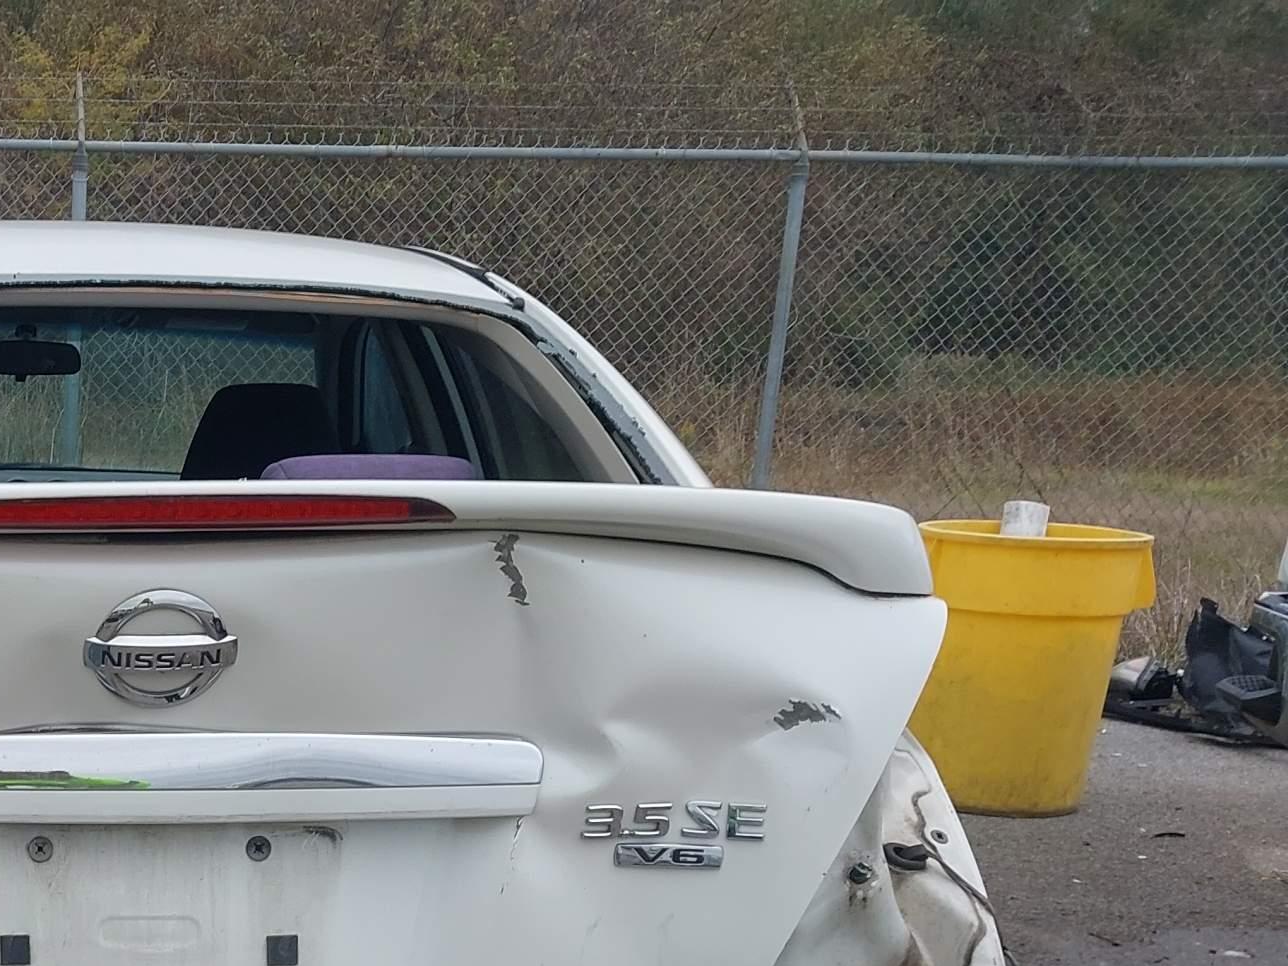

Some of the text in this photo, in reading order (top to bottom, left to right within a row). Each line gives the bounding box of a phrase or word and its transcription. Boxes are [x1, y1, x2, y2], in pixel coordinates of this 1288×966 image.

[100, 648, 222, 671] NISSAN
[580, 799, 768, 841] 3.5 SE
[632, 846, 705, 865] V6
